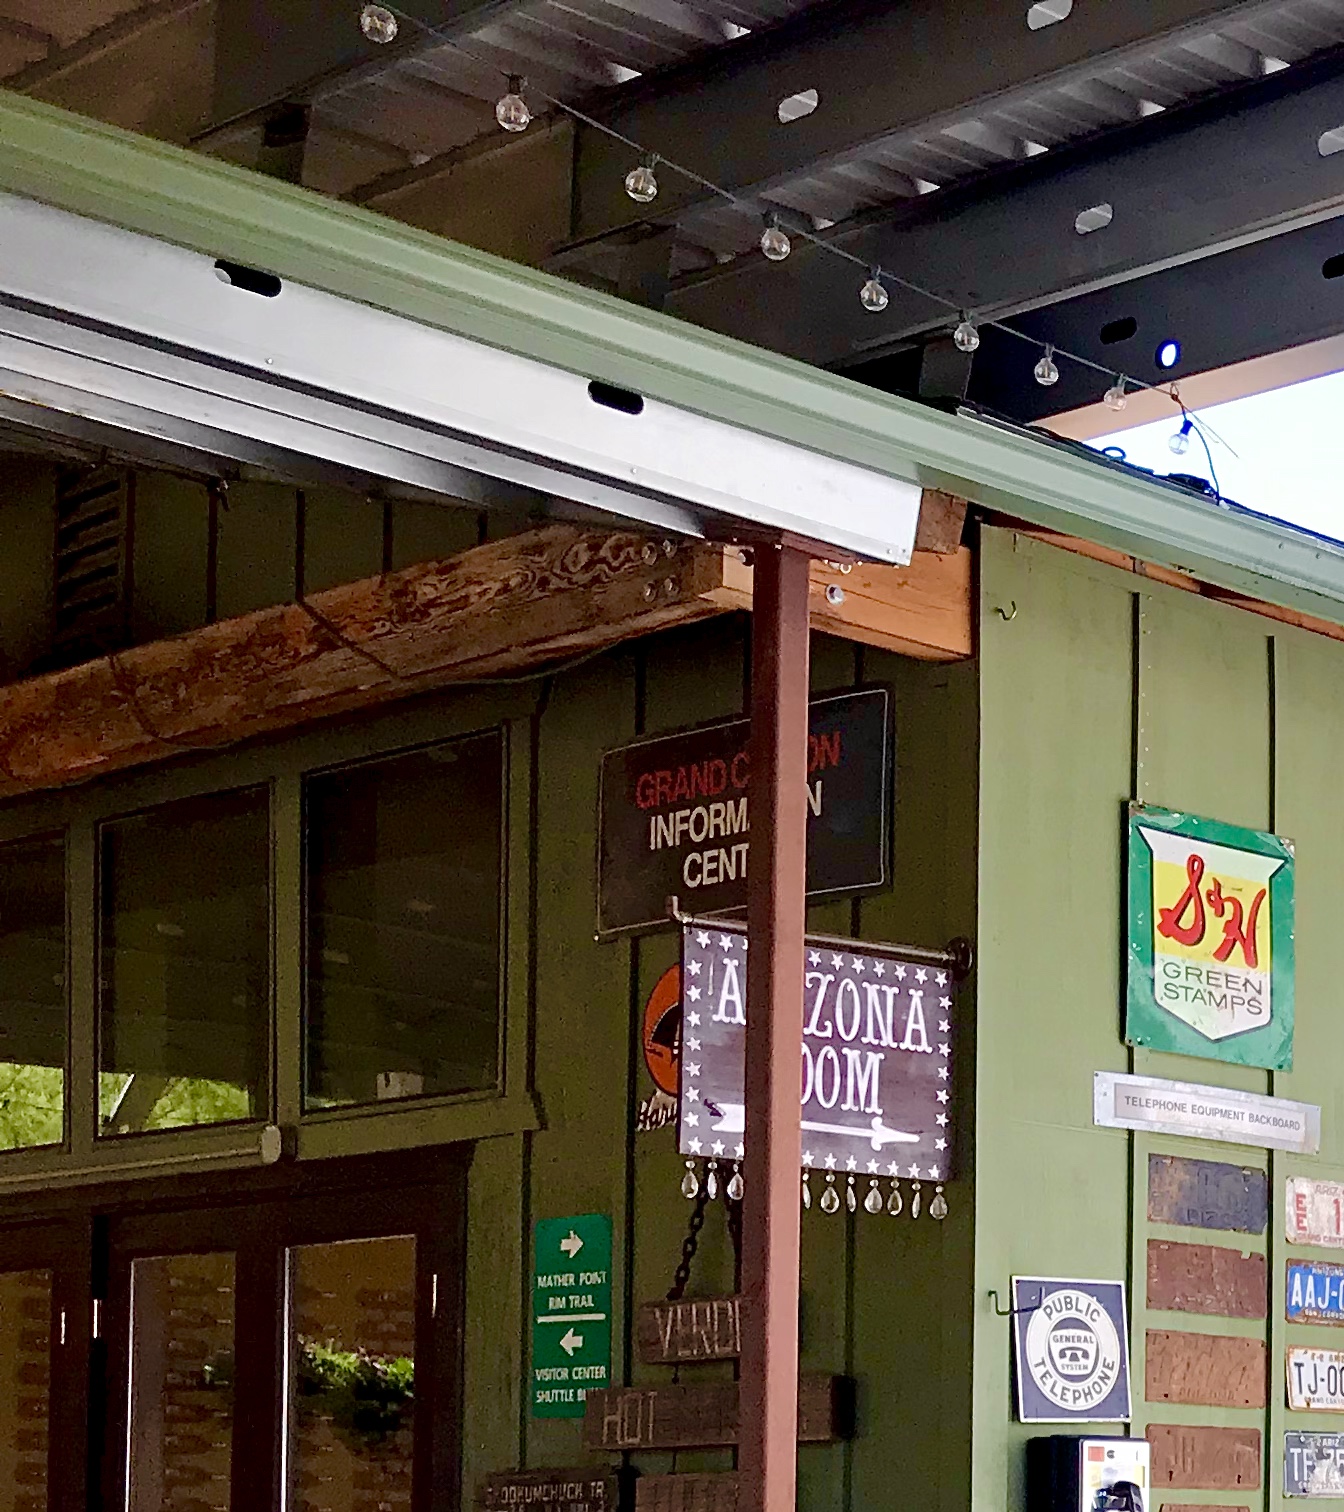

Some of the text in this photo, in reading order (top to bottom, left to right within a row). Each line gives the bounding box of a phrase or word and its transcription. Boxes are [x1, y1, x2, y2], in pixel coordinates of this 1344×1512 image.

[636, 759, 728, 810] GRAND
[683, 842, 749, 889] CENT
[1162, 961, 1263, 997] GREEN
[1163, 981, 1264, 1016] STAMPS
[1124, 1094, 1301, 1132] TELEPHONE EQUIPMENT BACKBOARD
[537, 1270, 607, 1289] MATHER POINT
[568, 1294, 595, 1309] TRAIL
[1043, 1295, 1101, 1323] PUBLIC
[1052, 1334, 1094, 1344] GENERAL
[535, 1365, 607, 1382] VISITOR CENTER
[1034, 1356, 1116, 1405] TELEPHONE
[1061, 1363, 1089, 1371] SYSTEM
[535, 1388, 575, 1404] SHUTTLE
